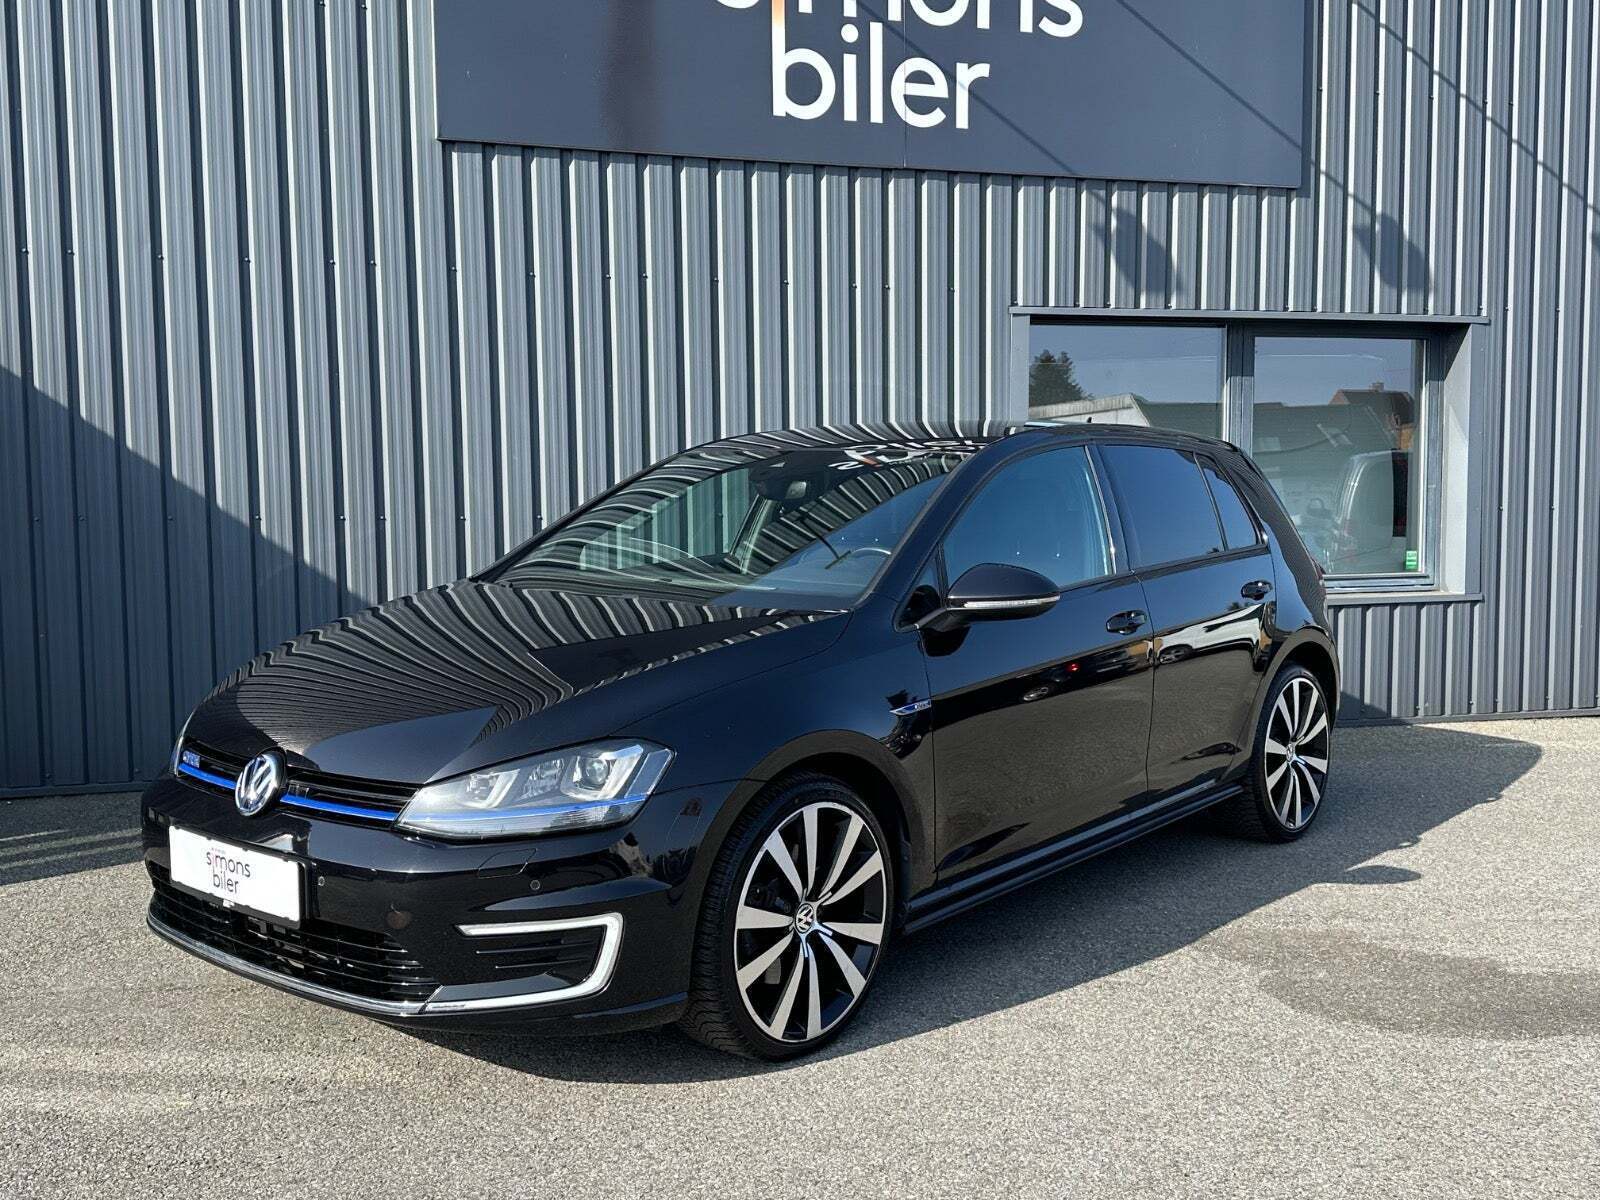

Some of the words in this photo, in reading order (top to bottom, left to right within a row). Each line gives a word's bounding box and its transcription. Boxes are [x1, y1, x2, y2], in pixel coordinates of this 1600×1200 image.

[771, 21, 991, 130] biler
[206, 851, 251, 878] simons
[213, 866, 239, 894] biler
